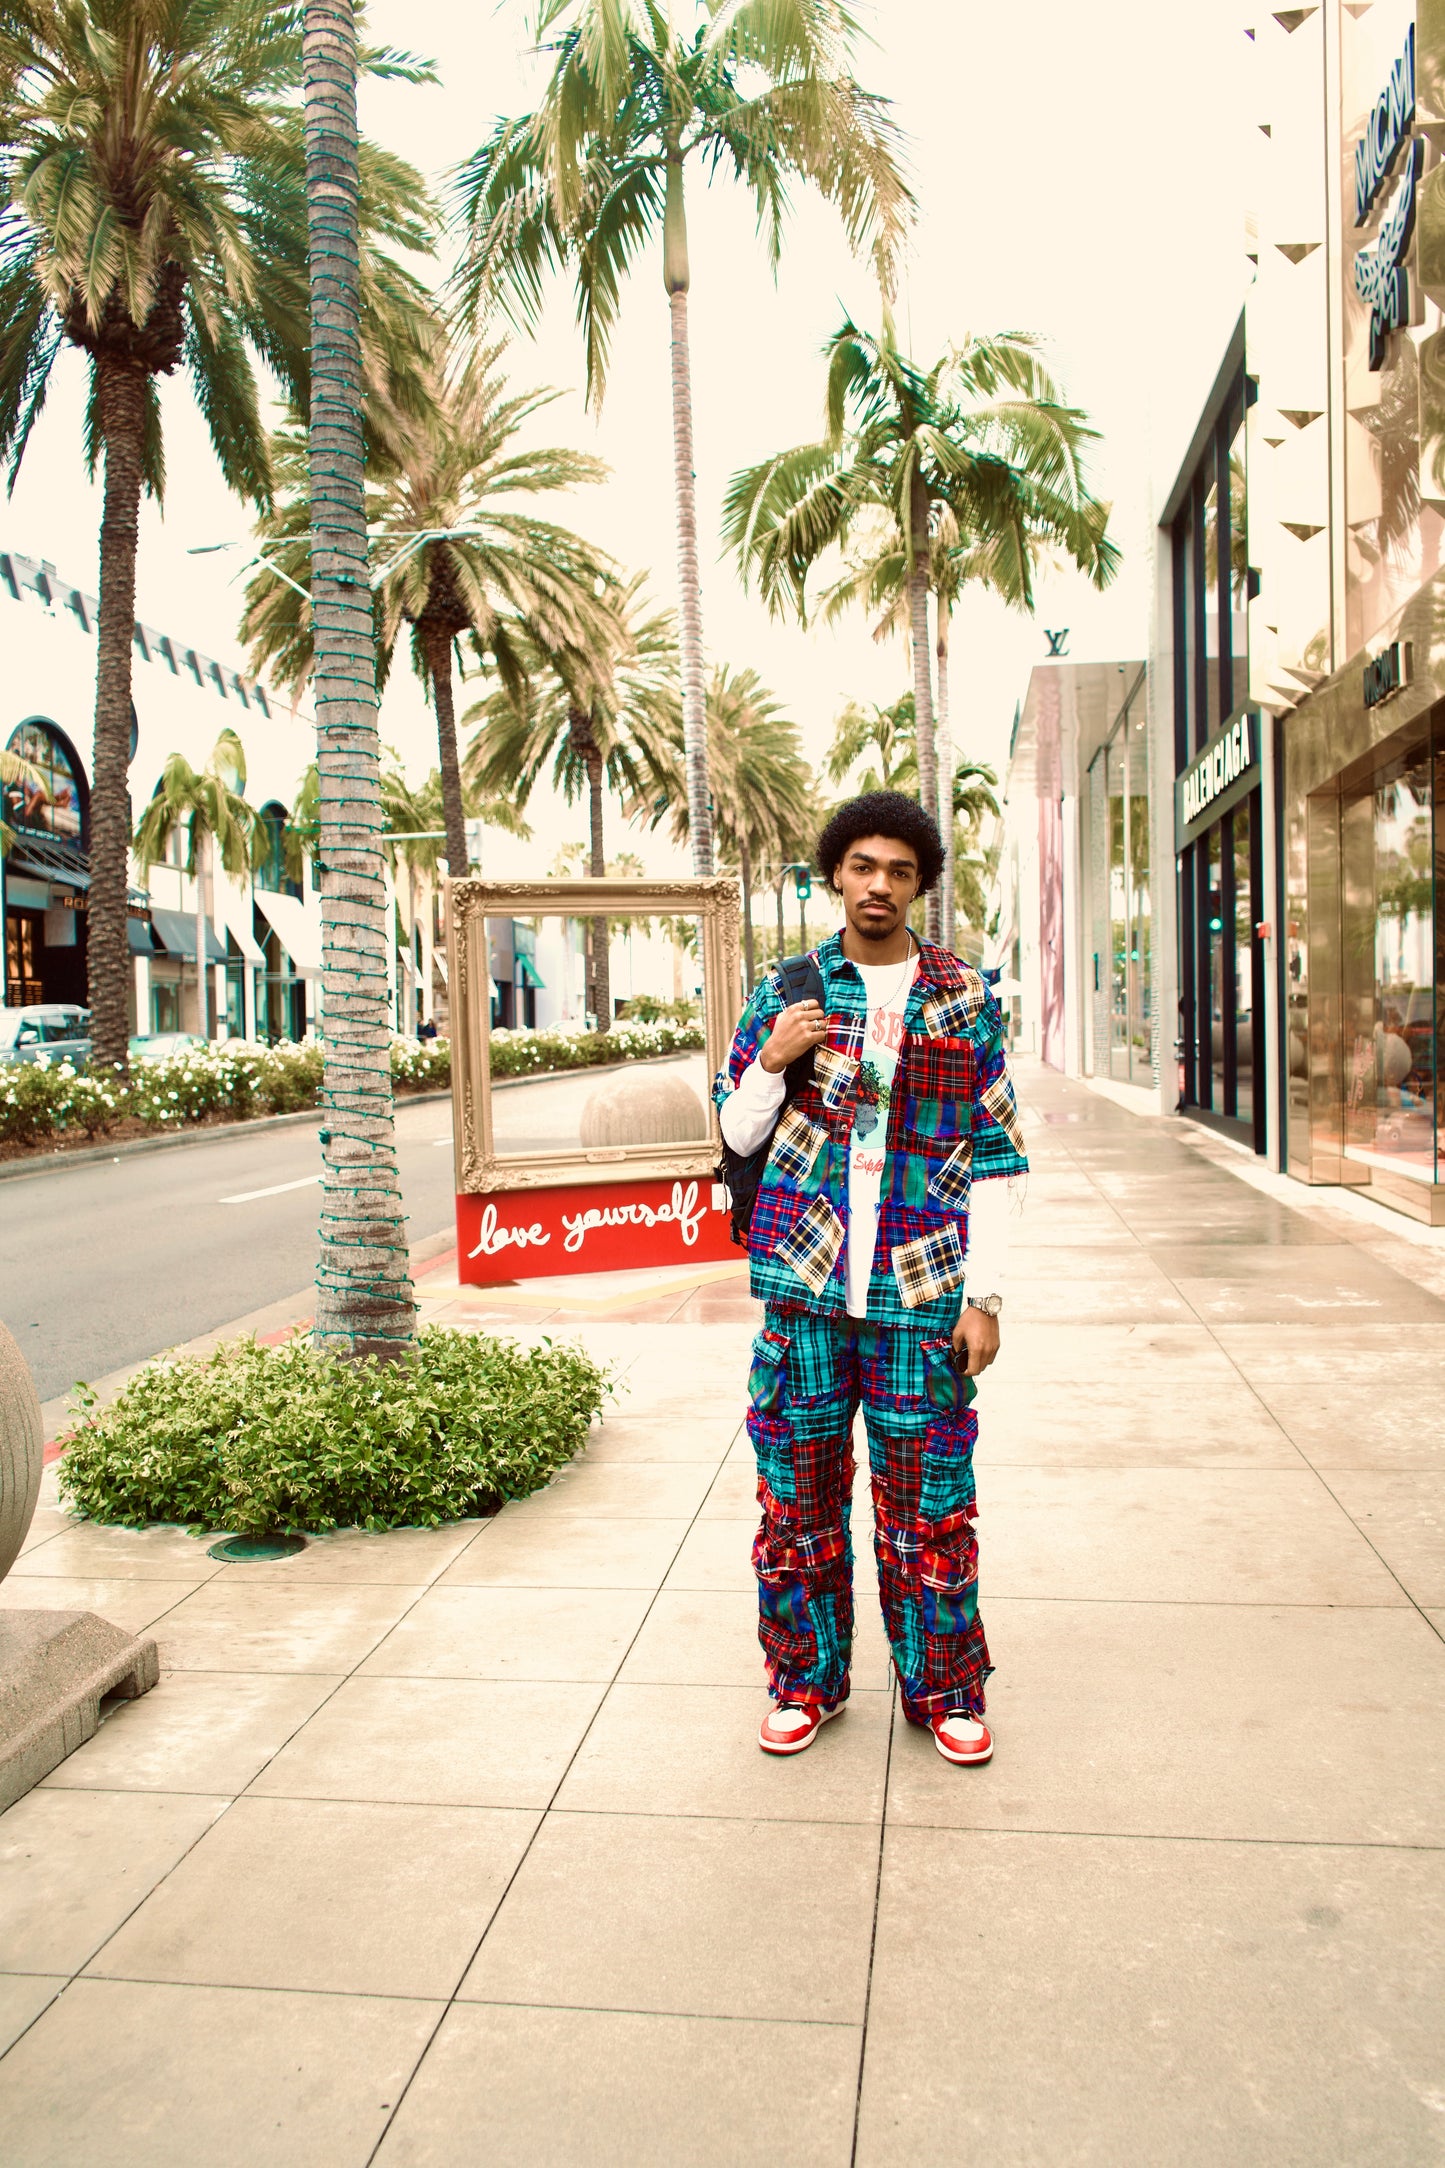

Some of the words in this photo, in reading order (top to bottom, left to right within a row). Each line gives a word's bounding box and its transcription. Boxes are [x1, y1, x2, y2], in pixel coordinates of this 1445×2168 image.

[1354, 22, 1415, 229] MCM
[1183, 713, 1250, 825] BALENCIAGA
[467, 1203, 551, 1259] love
[562, 1181, 707, 1252] yourself
